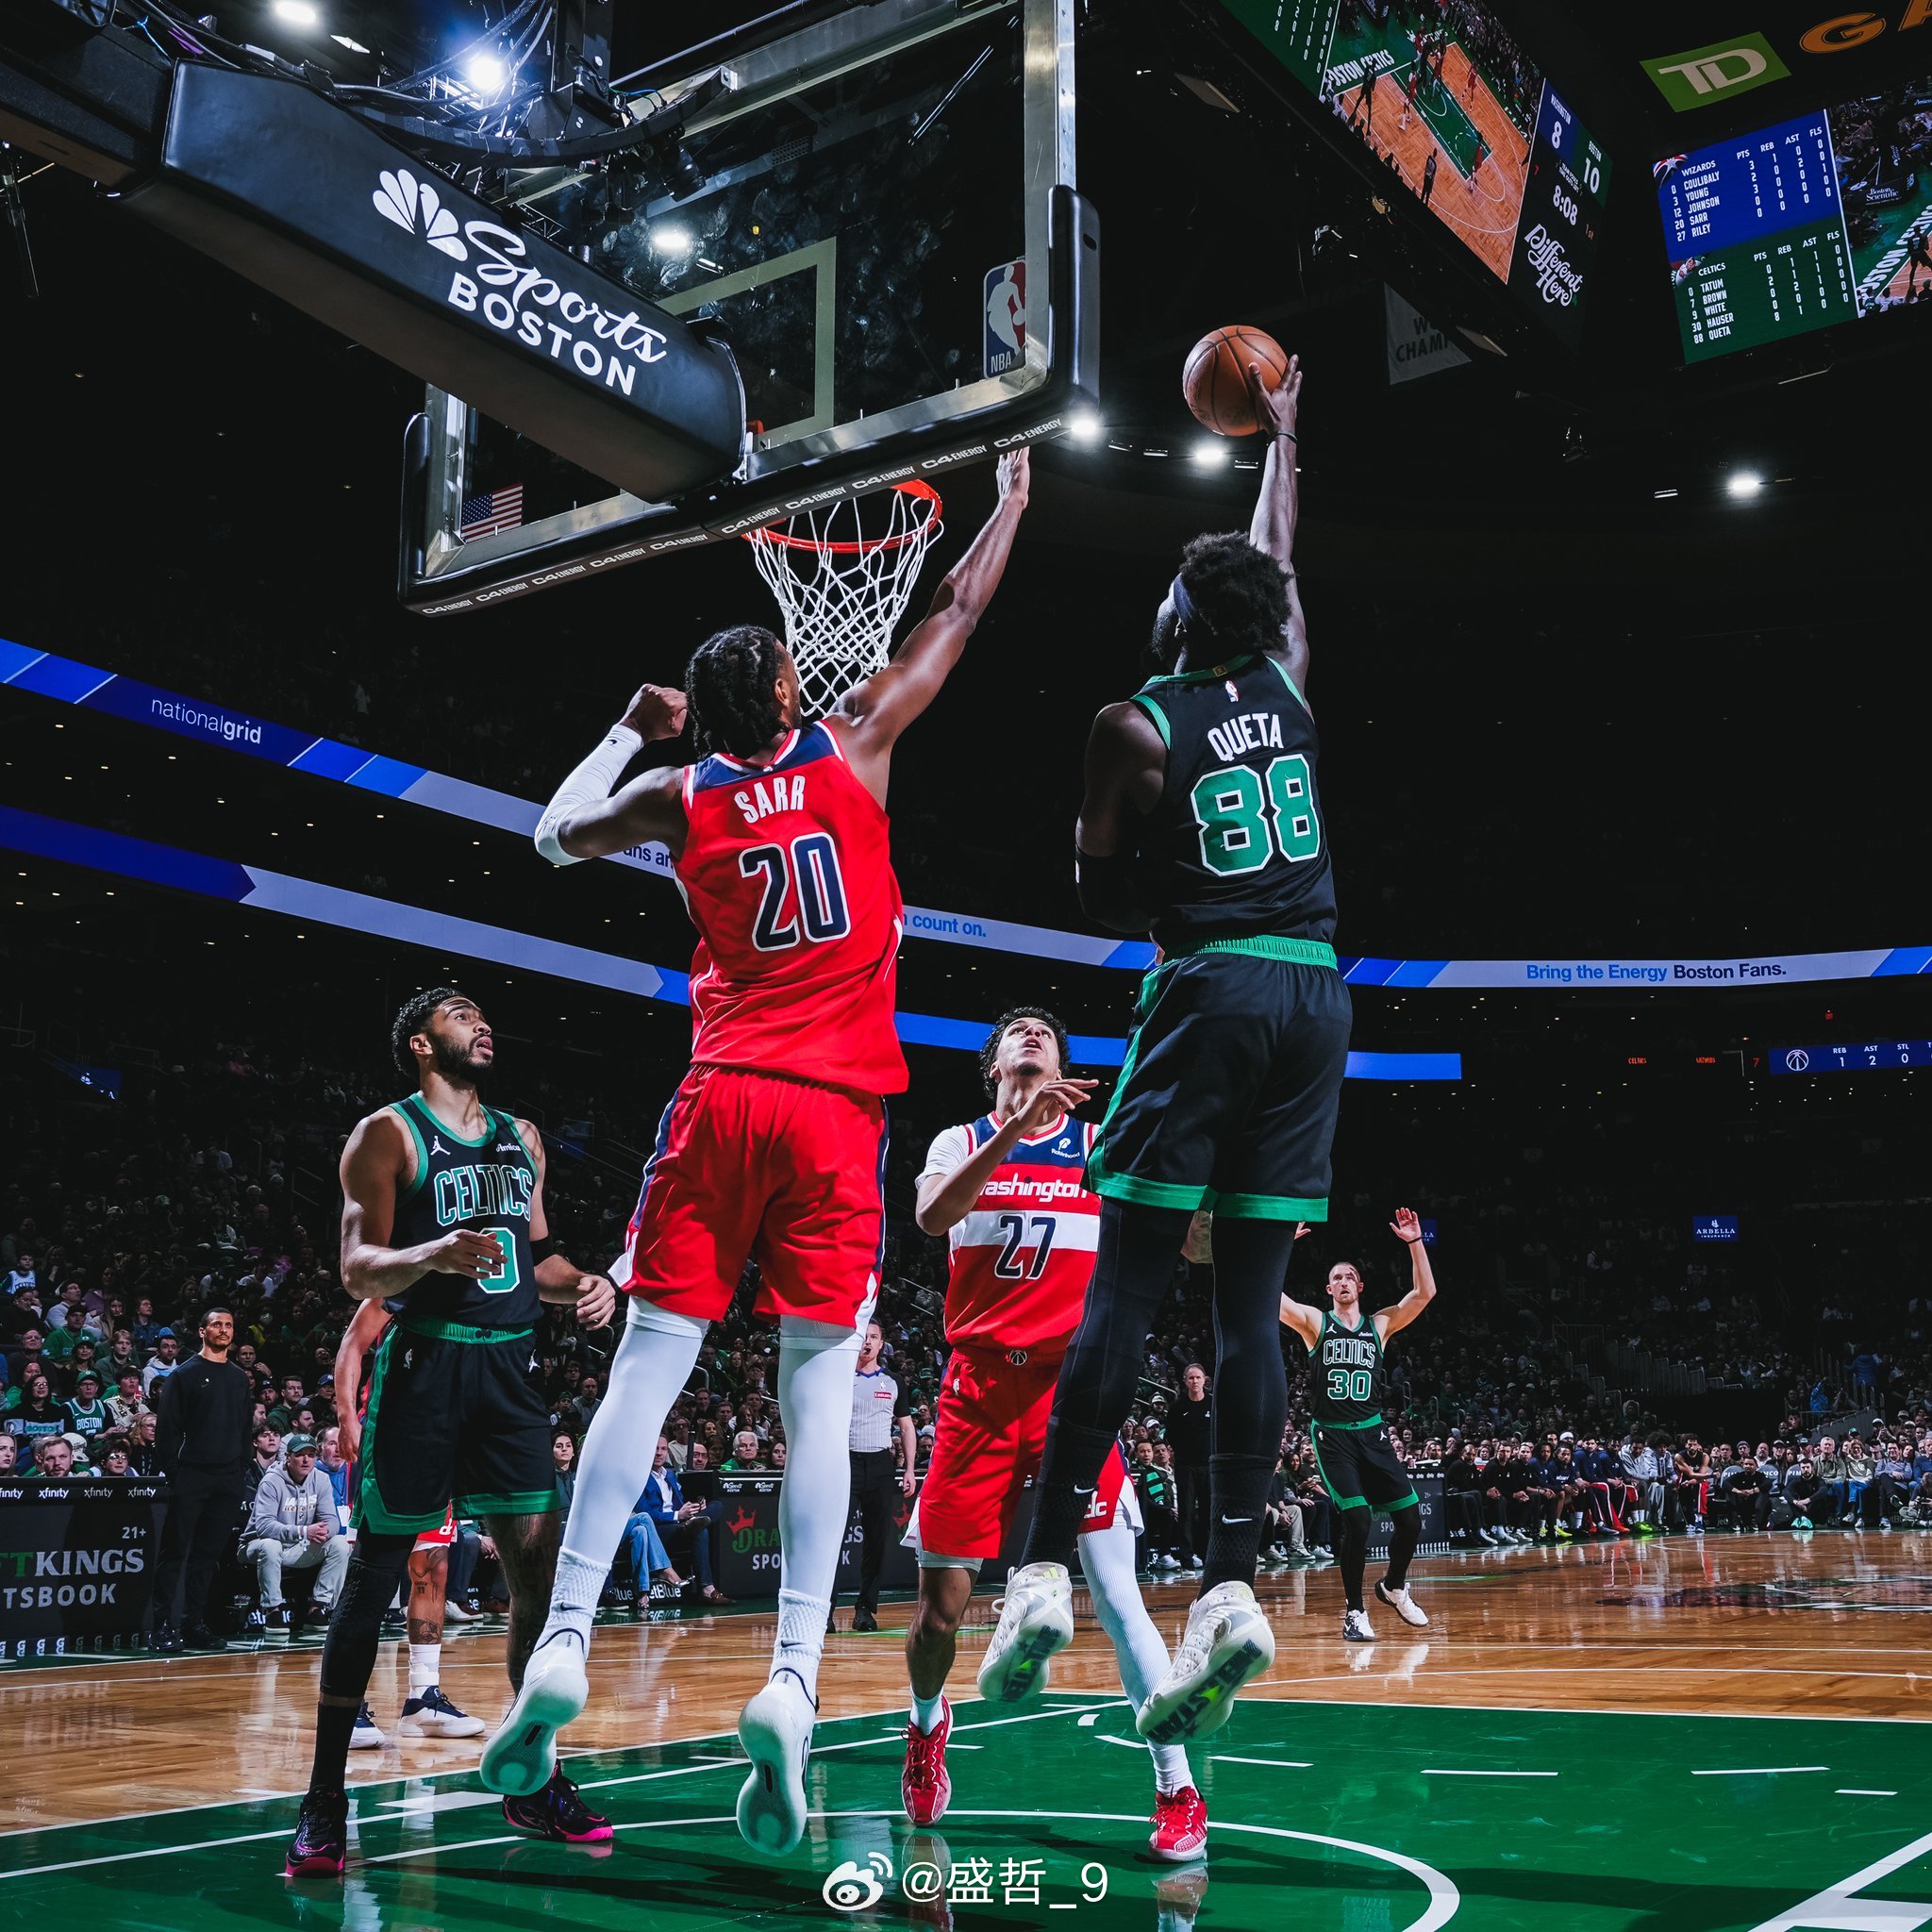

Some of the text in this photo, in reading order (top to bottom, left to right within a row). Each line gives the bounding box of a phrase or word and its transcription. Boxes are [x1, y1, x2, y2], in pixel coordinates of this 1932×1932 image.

[1657, 48, 1767, 94] TD
[1552, 122, 1562, 148] 8
[1682, 126, 1822, 176] WIZARDS PTS REB AST FLS
[1584, 157, 1600, 193] 10
[1672, 140, 1823, 193] 0 COULIBALY 3 1 0 0
[1674, 151, 1824, 206] 3 YOUNG 2 0 2 0
[1674, 163, 1826, 217] 12 JOHNSON 3 0 0 1
[1553, 185, 1577, 225] 8:08
[1675, 175, 1829, 230] 20 SARR 0 0 0 0
[1677, 188, 1831, 242] 27 RILEY 0 0 0 0
[1524, 224, 1583, 292] Different
[1528, 250, 1573, 306] Here
[1689, 244, 1840, 296] 0 TATUM 0 1 1 0
[1698, 231, 1840, 276] CELTICS PTS REB AST FLS
[465, 221, 666, 363] Sports
[1690, 257, 1842, 308] 7 BROWN 2 1 1 0
[1692, 269, 1844, 320] 9 WHITE 0 2 1 0
[1692, 281, 1846, 332] 30 HAUSER 0 0 0 0
[448, 272, 636, 395] BOSTON
[1694, 293, 1848, 344] 88 QUETA 8 1 0 0
[991, 351, 1011, 374] NBA
[152, 699, 261, 743] nationalgrid
[1208, 712, 1284, 761] QUETA
[734, 775, 806, 824] SARR
[1191, 754, 1320, 876] 88
[739, 832, 851, 952] 20
[913, 915, 958, 933] count
[962, 923, 987, 937] on.
[1526, 963, 1787, 982] Bring the Energy Boston Fans.
[1840, 1058, 1844, 1067] 1
[1869, 1056, 1876, 1066] 2
[1902, 1054, 1908, 1063] 0
[496, 1143, 521, 1152] Amica
[1051, 1148, 1080, 1158] Robinhood
[434, 1165, 532, 1226] CELTICS
[994, 1214, 1057, 1279] 27
[1324, 1339, 1375, 1369] CELTICS
[1327, 1369, 1372, 1401] 30
[76, 1417, 102, 1430] BOSTON
[39, 1488, 69, 1499] xfinity
[84, 1488, 113, 1498] xfinity
[128, 1488, 157, 1497] xfinity
[122, 1526, 146, 1540] 21+
[0, 1549, 144, 1577] TKINGS
